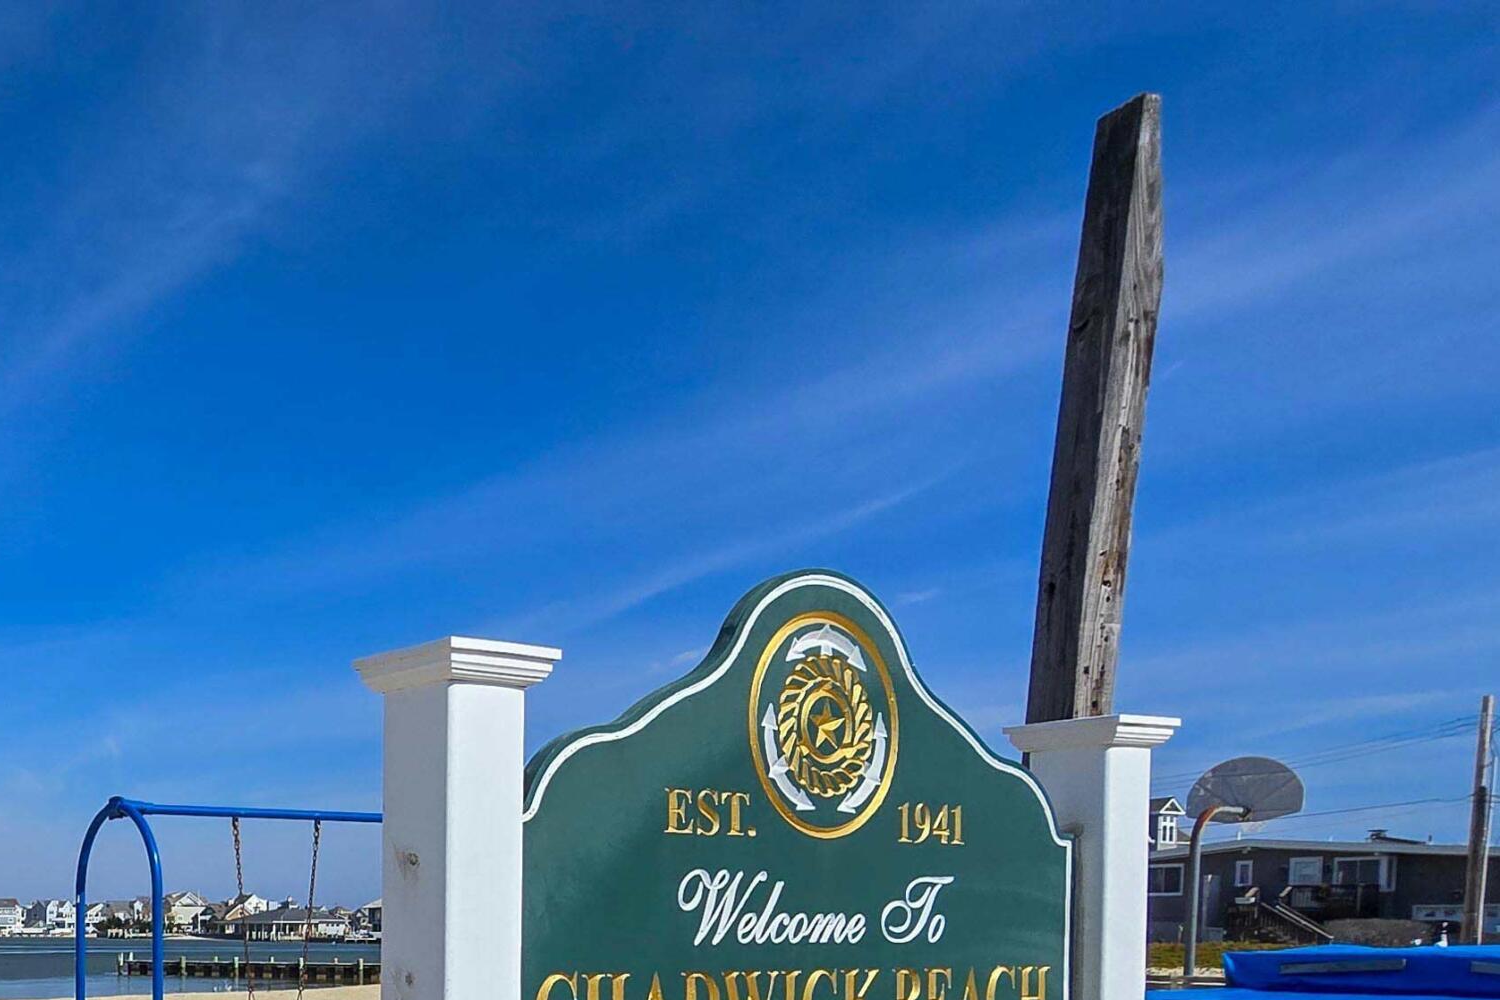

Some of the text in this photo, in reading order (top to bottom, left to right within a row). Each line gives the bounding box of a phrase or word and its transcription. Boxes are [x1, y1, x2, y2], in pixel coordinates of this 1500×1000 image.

[664, 787, 965, 846] EST. 1941
[677, 868, 955, 946] Welcome To
